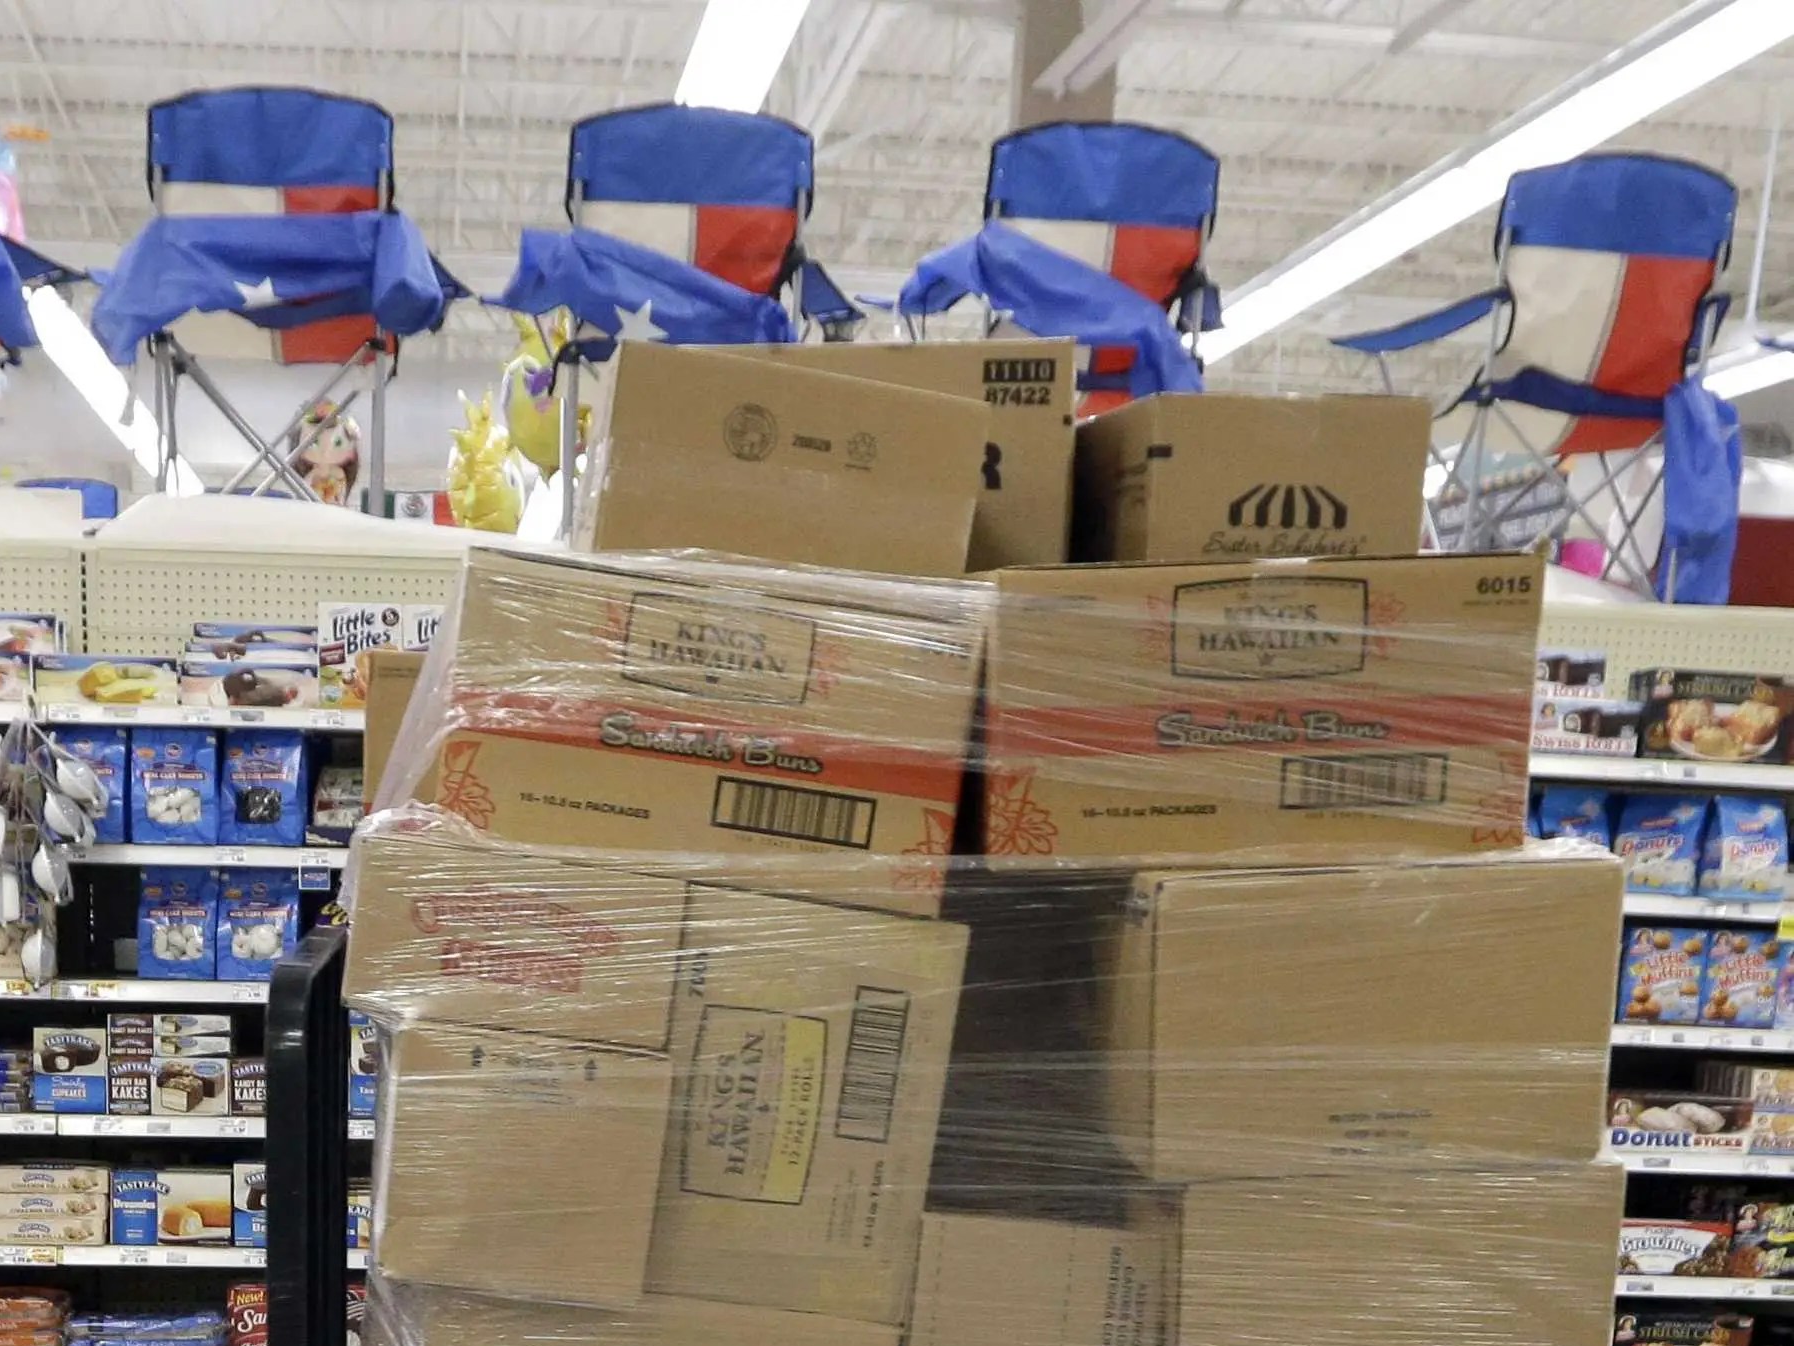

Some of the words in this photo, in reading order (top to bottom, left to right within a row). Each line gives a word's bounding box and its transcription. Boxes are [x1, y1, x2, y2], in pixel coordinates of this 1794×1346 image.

[985, 386, 1051, 406] 87422
[1476, 576, 1532, 595] 6015
[332, 608, 376, 642] Little
[1223, 603, 1319, 627] KING'S
[346, 629, 392, 655] Bites
[676, 620, 768, 652] KING'S
[1198, 630, 1339, 652] HAWAIIAN
[648, 638, 787, 674] HAWAIIAN
[1154, 709, 1298, 748] Sandwich
[1301, 709, 1390, 741] Buns
[600, 711, 733, 762] Sandwich
[741, 732, 824, 774] Buns
[584, 800, 651, 820] PACKAGES
[1149, 803, 1218, 818] PACKAGES
[43, 1033, 96, 1048] TASTYKAKE
[111, 1077, 130, 1085] KANDY
[134, 1077, 147, 1085] BAR
[234, 1080, 255, 1089] KANDY
[111, 1086, 148, 1099] KAKES
[723, 1029, 766, 1176] HAWAIIAN
[1611, 1126, 1692, 1148] Donut
[115, 1180, 170, 1195] TASTYKAKE
[1620, 1235, 1700, 1257] Brownies
[236, 1290, 264, 1306] New!
